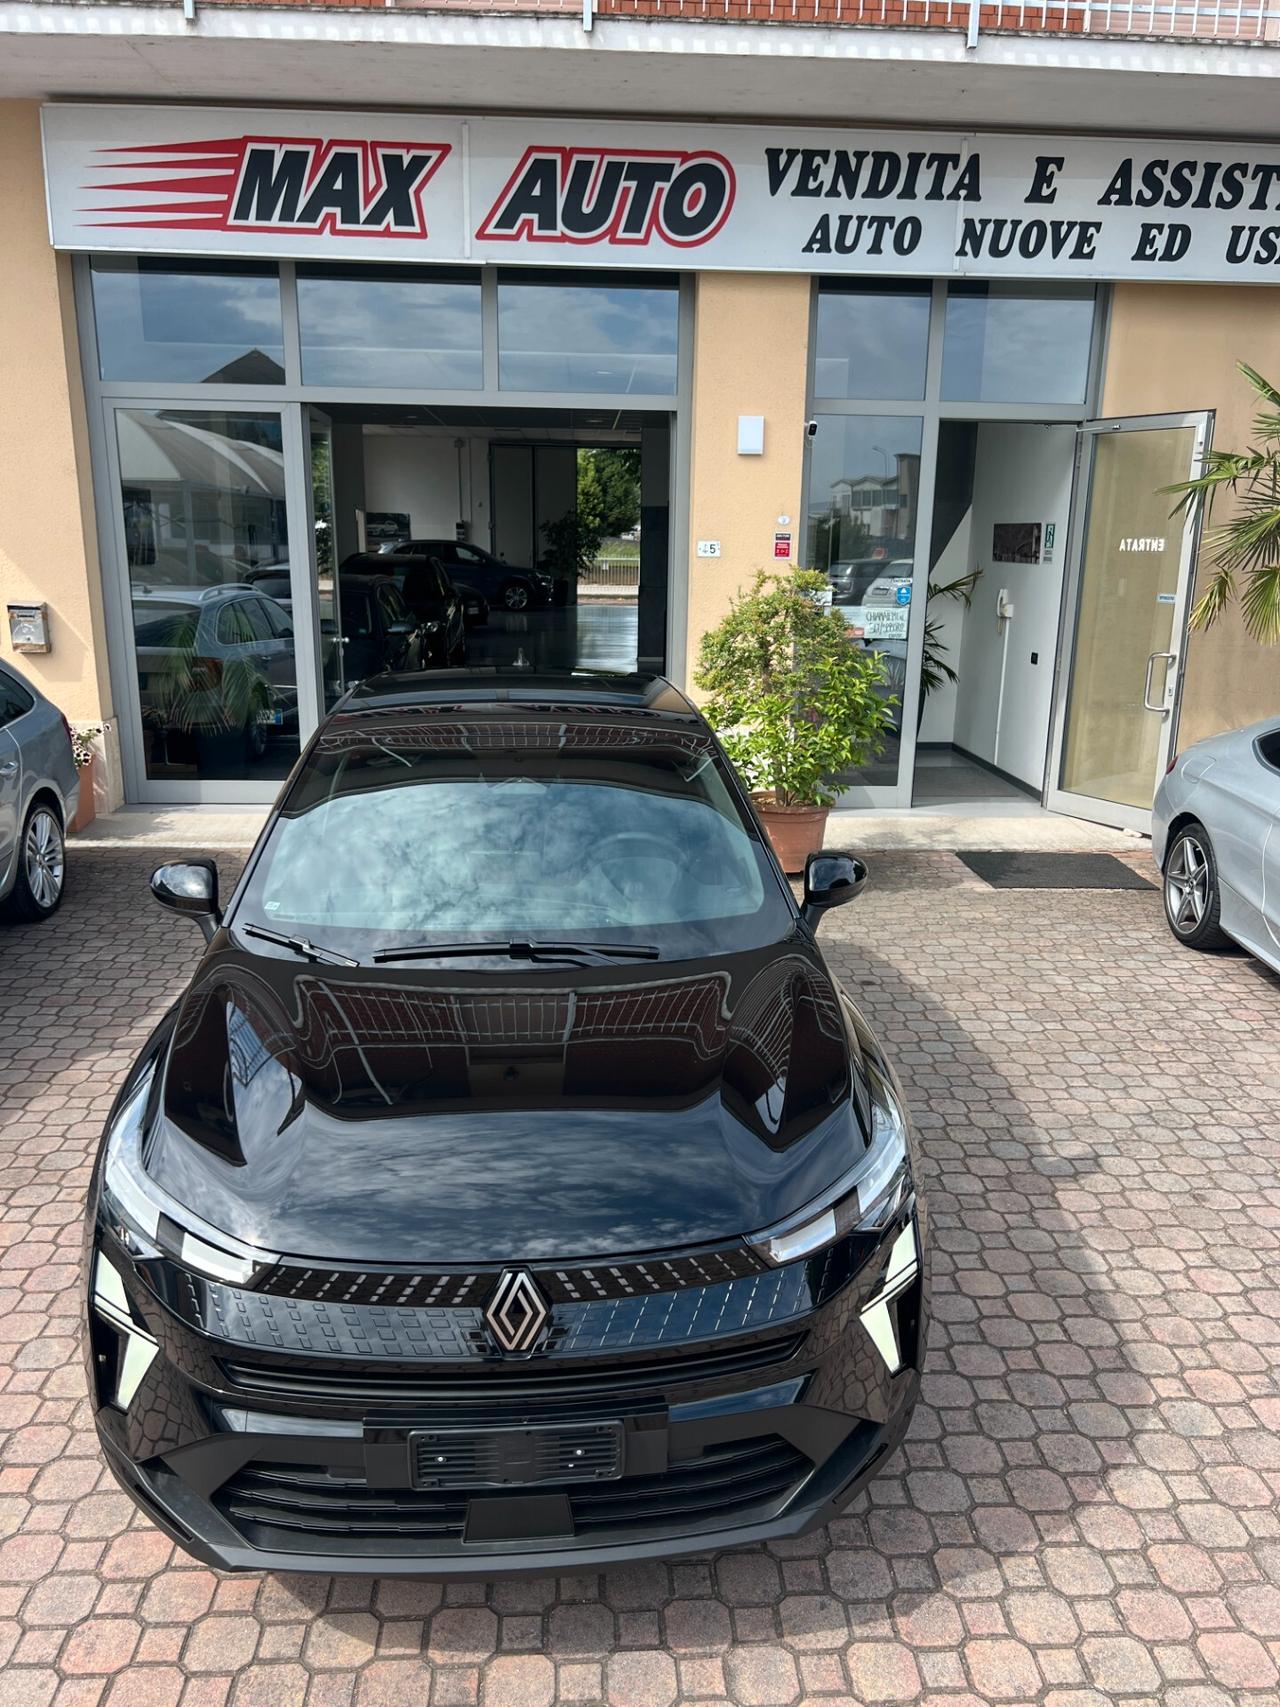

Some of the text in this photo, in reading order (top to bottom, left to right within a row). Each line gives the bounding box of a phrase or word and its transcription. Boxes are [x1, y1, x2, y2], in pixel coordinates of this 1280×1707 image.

[228, 140, 733, 245] MAX AUTO
[765, 148, 1280, 210] VENDITA E ASSIST
[802, 214, 1280, 264] AUTO NUOVE ED US
